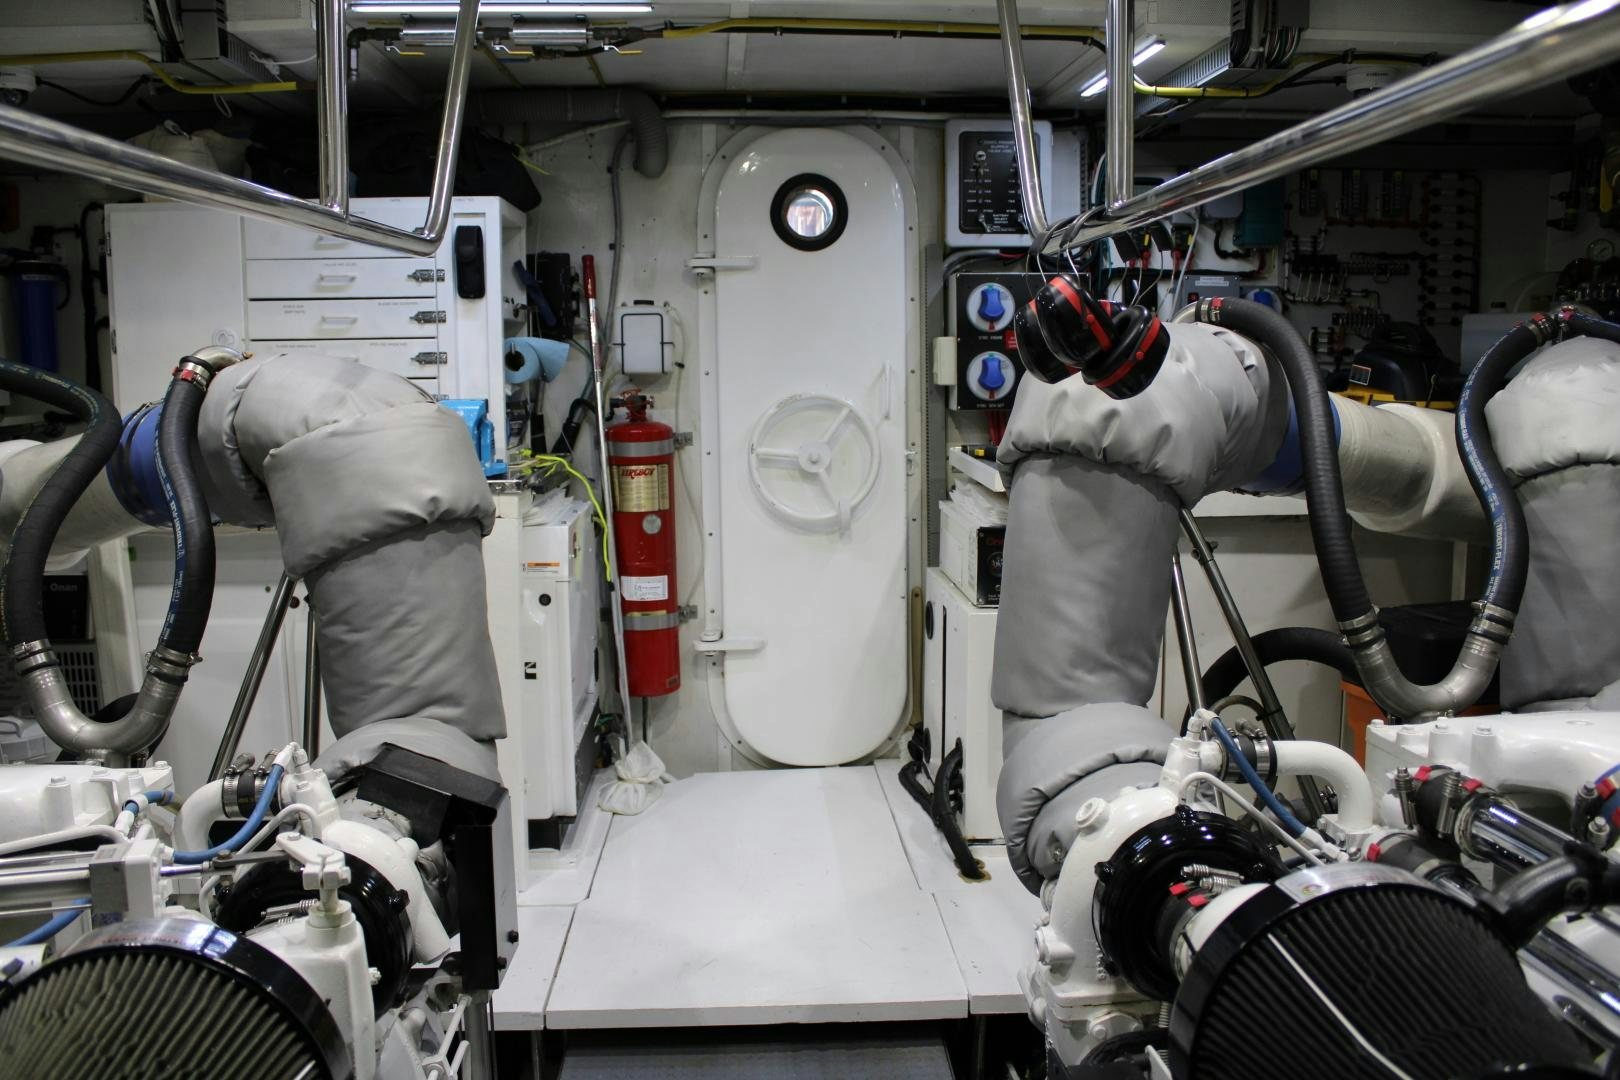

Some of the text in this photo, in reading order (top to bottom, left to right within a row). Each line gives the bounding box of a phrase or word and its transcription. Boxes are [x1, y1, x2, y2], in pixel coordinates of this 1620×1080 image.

[170, 500, 183, 549] TRIDENT-FLEX
[1493, 522, 1504, 571] TRIDENT-FLEX
[49, 582, 78, 592] Onan
